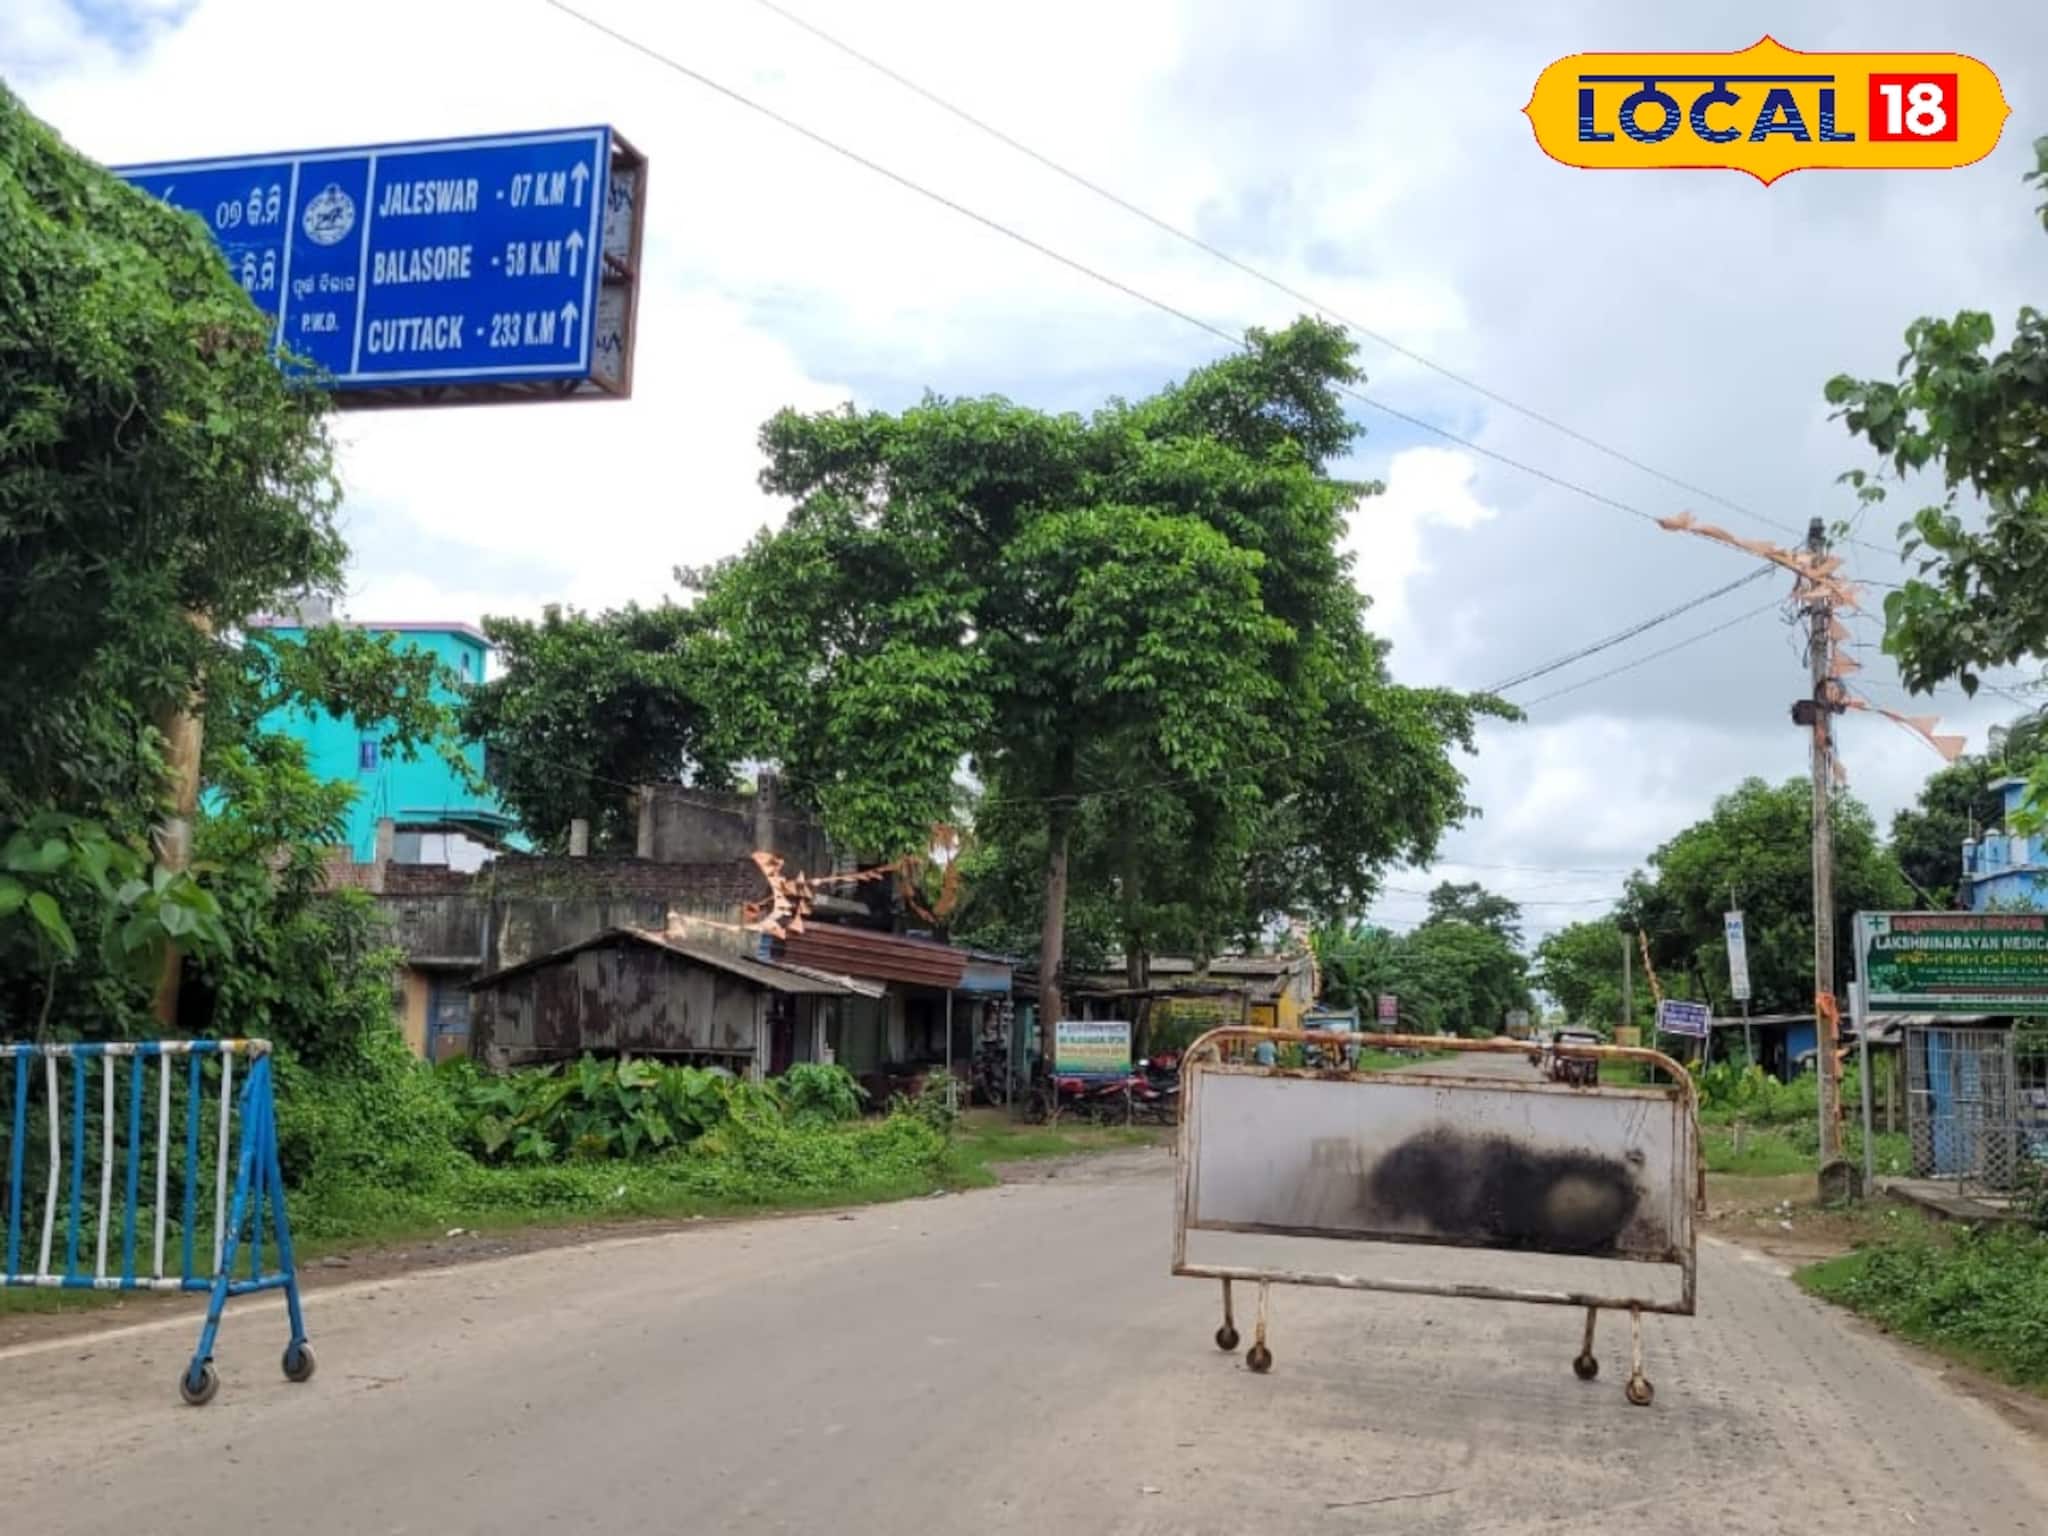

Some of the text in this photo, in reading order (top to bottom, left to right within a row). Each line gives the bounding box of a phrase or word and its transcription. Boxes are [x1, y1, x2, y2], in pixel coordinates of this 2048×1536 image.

[379, 178, 479, 217] JALESWAR
[511, 173, 532, 208] 07
[373, 245, 473, 285] BALASORE
[505, 242, 526, 277] 58
[368, 315, 464, 353] CUTTACK
[490, 313, 521, 348] 233
[1876, 936, 2048, 950] LAKSHMINARAYAN MEDIC
